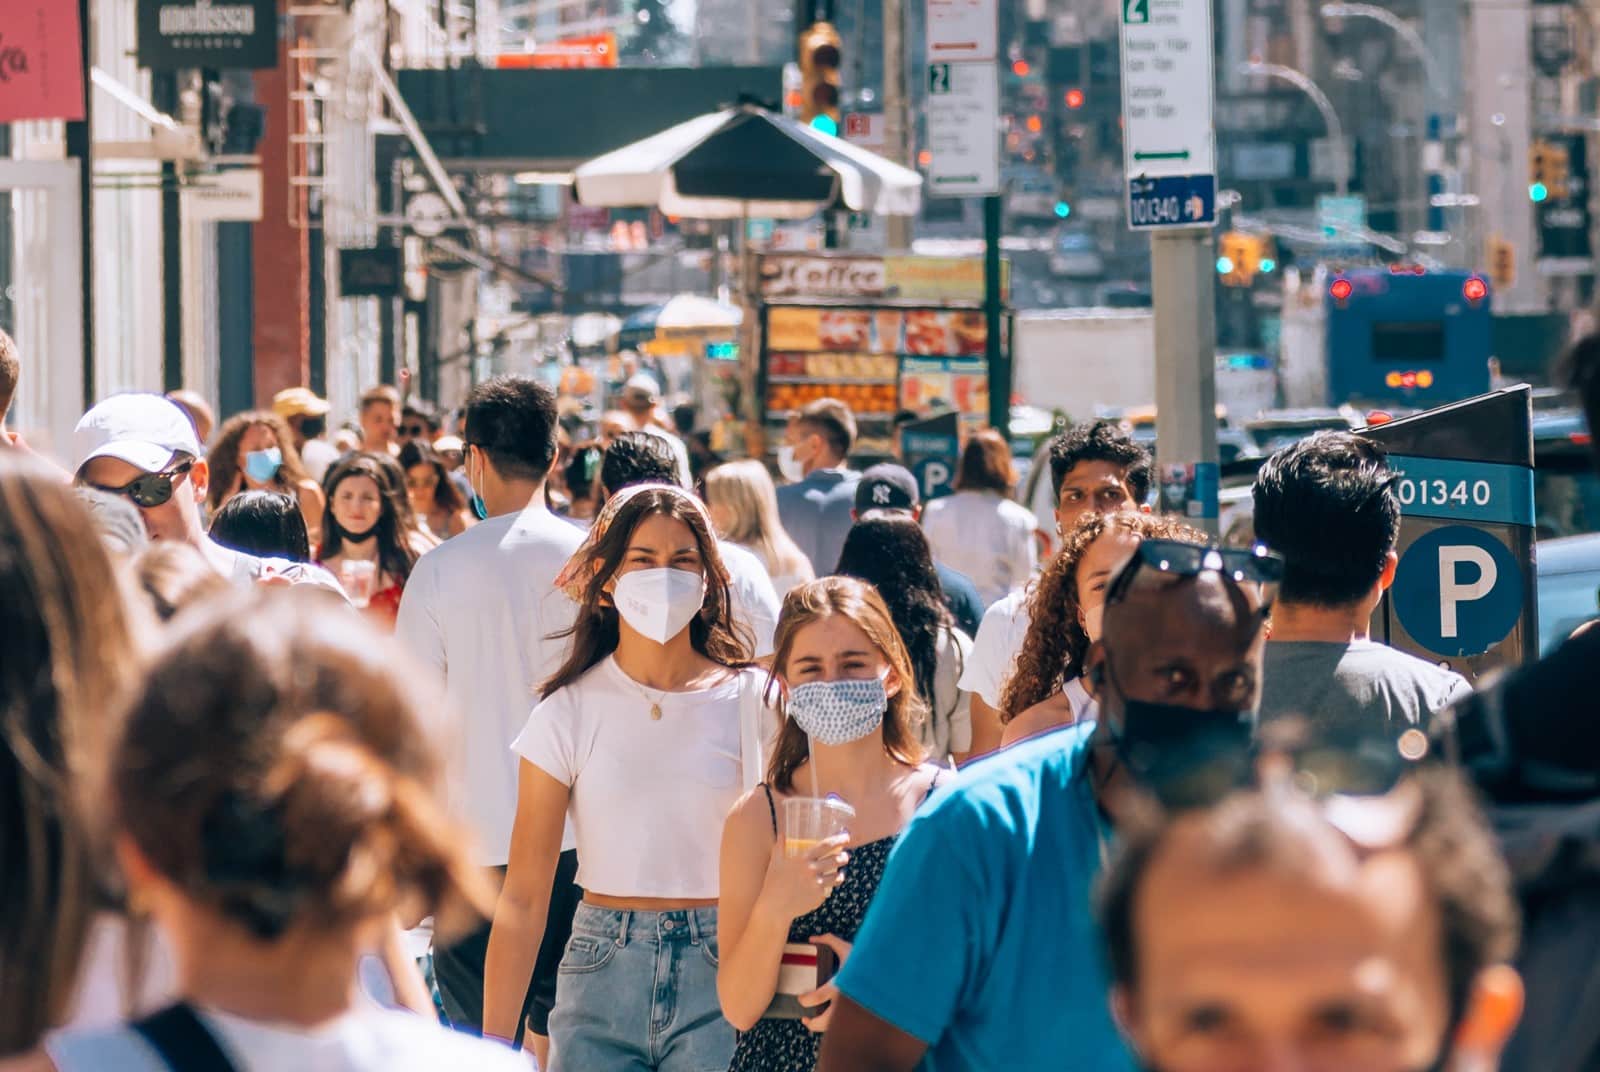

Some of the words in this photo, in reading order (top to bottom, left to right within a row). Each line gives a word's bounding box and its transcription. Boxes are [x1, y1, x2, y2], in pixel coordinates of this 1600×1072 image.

[1132, 197, 1180, 222] 101340
[787, 263, 878, 286] Coffee
[924, 462, 949, 496] P
[872, 484, 891, 504] NY
[1398, 479, 1490, 505] 01340
[1439, 545, 1498, 638] P
